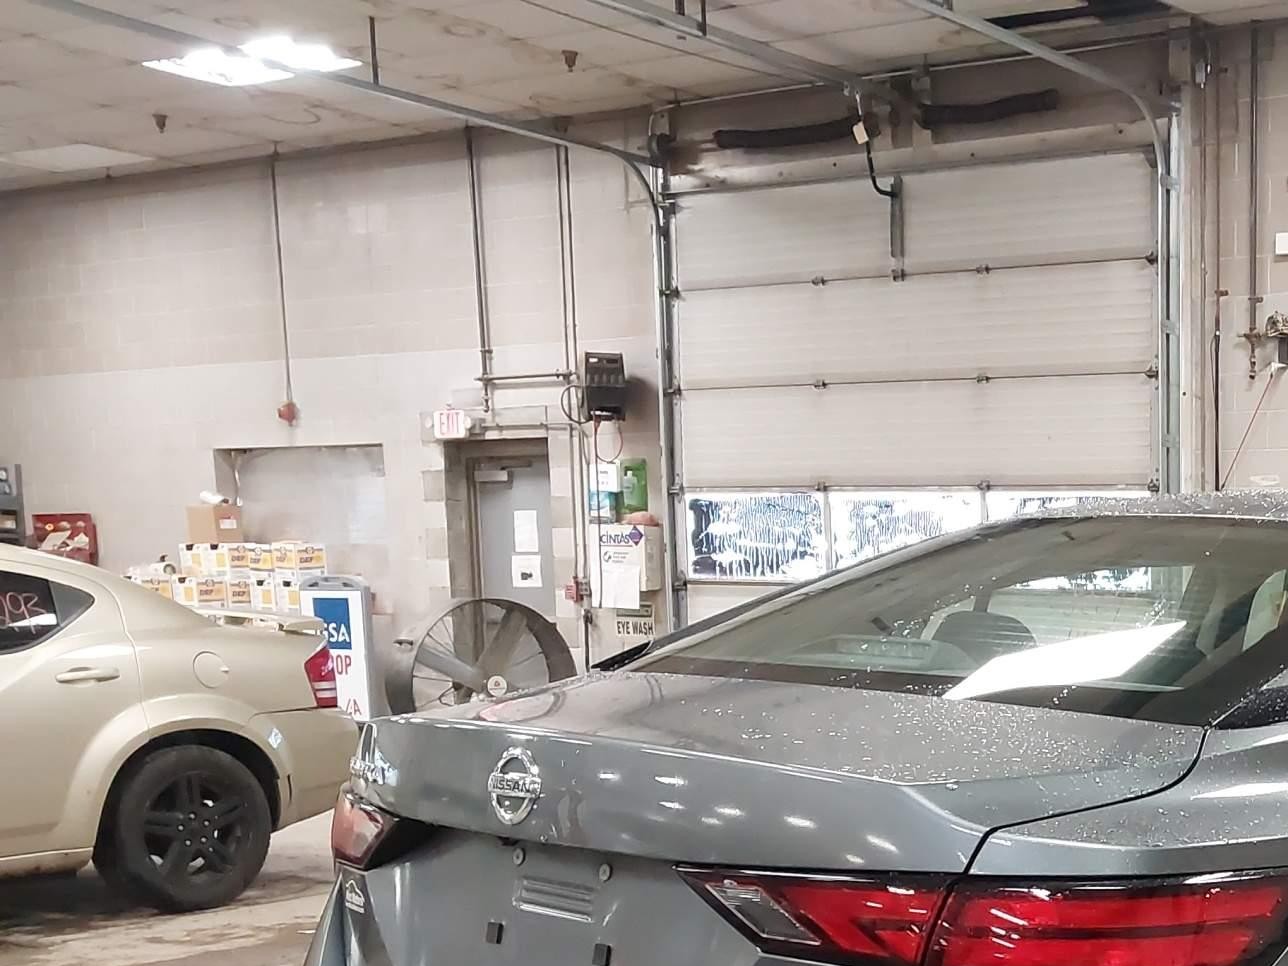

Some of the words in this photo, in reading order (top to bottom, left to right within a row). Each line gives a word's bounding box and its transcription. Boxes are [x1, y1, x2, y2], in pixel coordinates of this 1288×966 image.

[439, 411, 460, 436] EXIT
[601, 530, 631, 545] CINTAS
[616, 621, 631, 635] EYE
[632, 621, 654, 636] WASH
[493, 776, 531, 793] NISSAN
